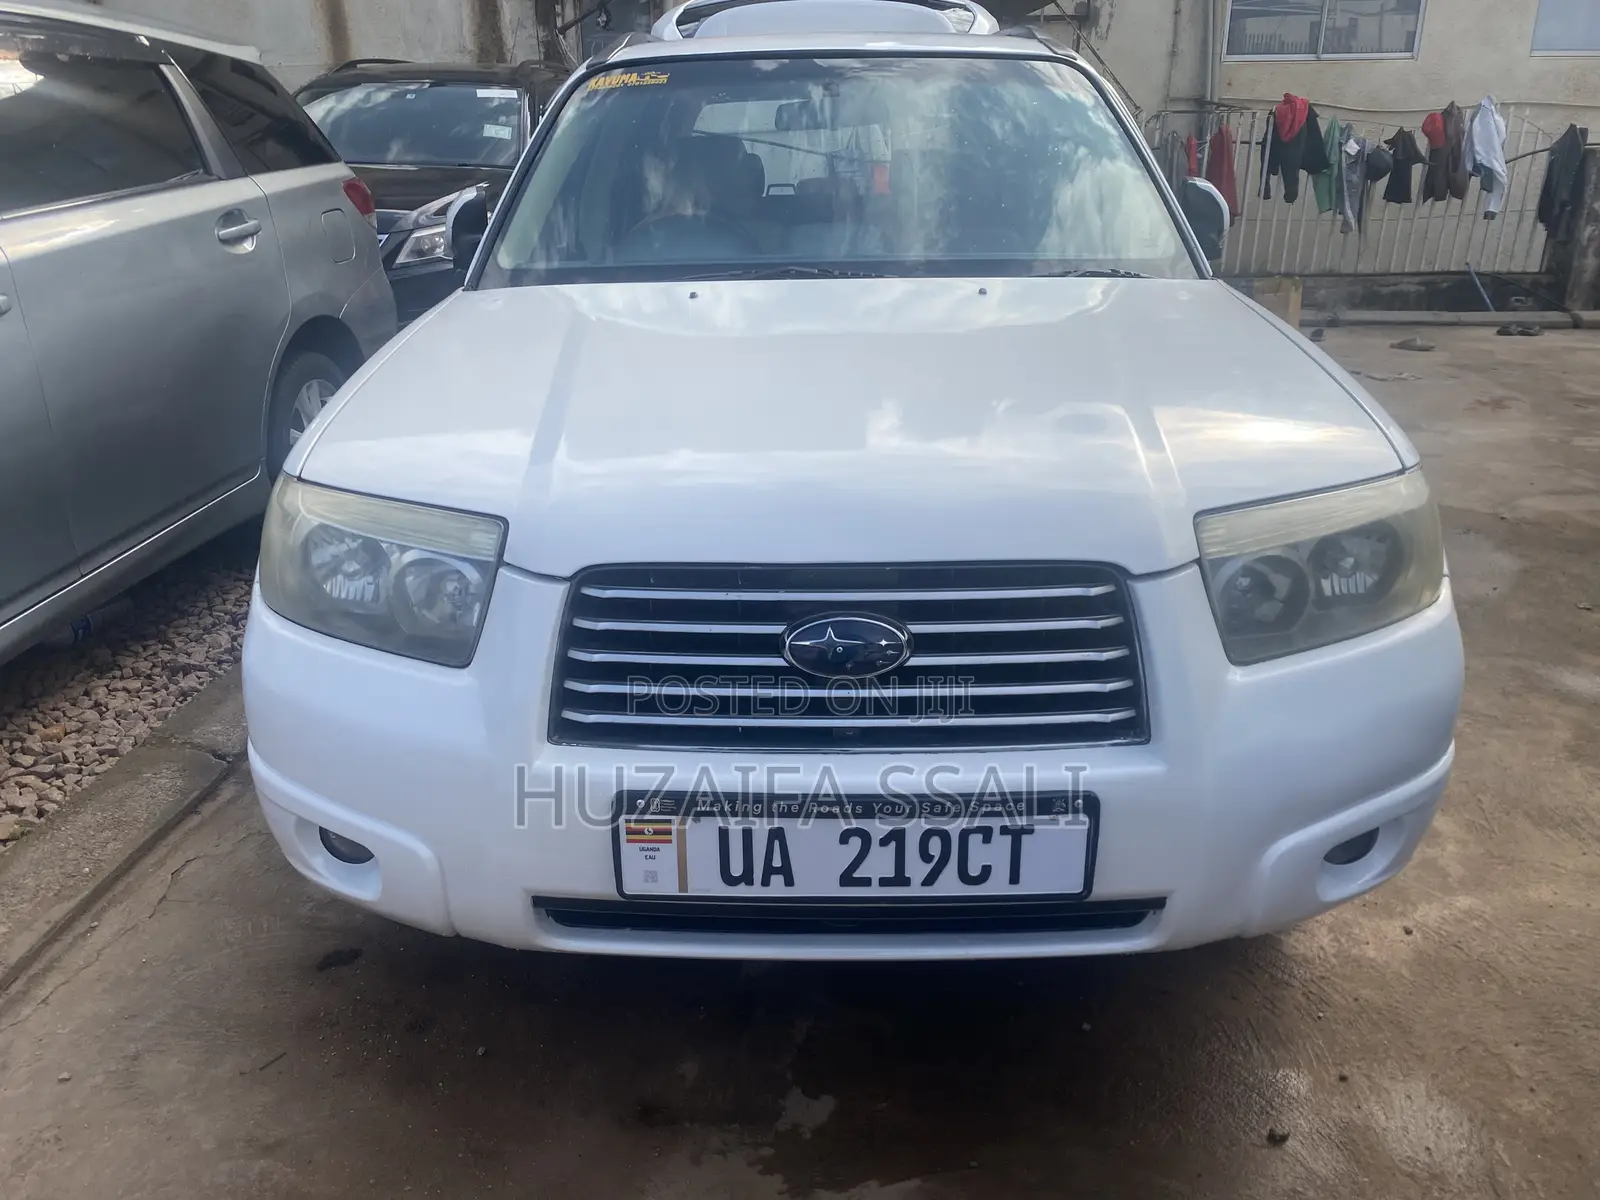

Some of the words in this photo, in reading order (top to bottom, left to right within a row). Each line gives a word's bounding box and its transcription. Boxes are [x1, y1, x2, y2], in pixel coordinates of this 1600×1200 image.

[697, 800, 763, 815] Making
[771, 801, 800, 813] the
[808, 802, 863, 814] Roads
[872, 802, 912, 814] Your
[921, 802, 961, 814] Safe
[969, 801, 1025, 815] Space
[718, 825, 796, 888] UA
[838, 825, 1036, 888] 219CT
